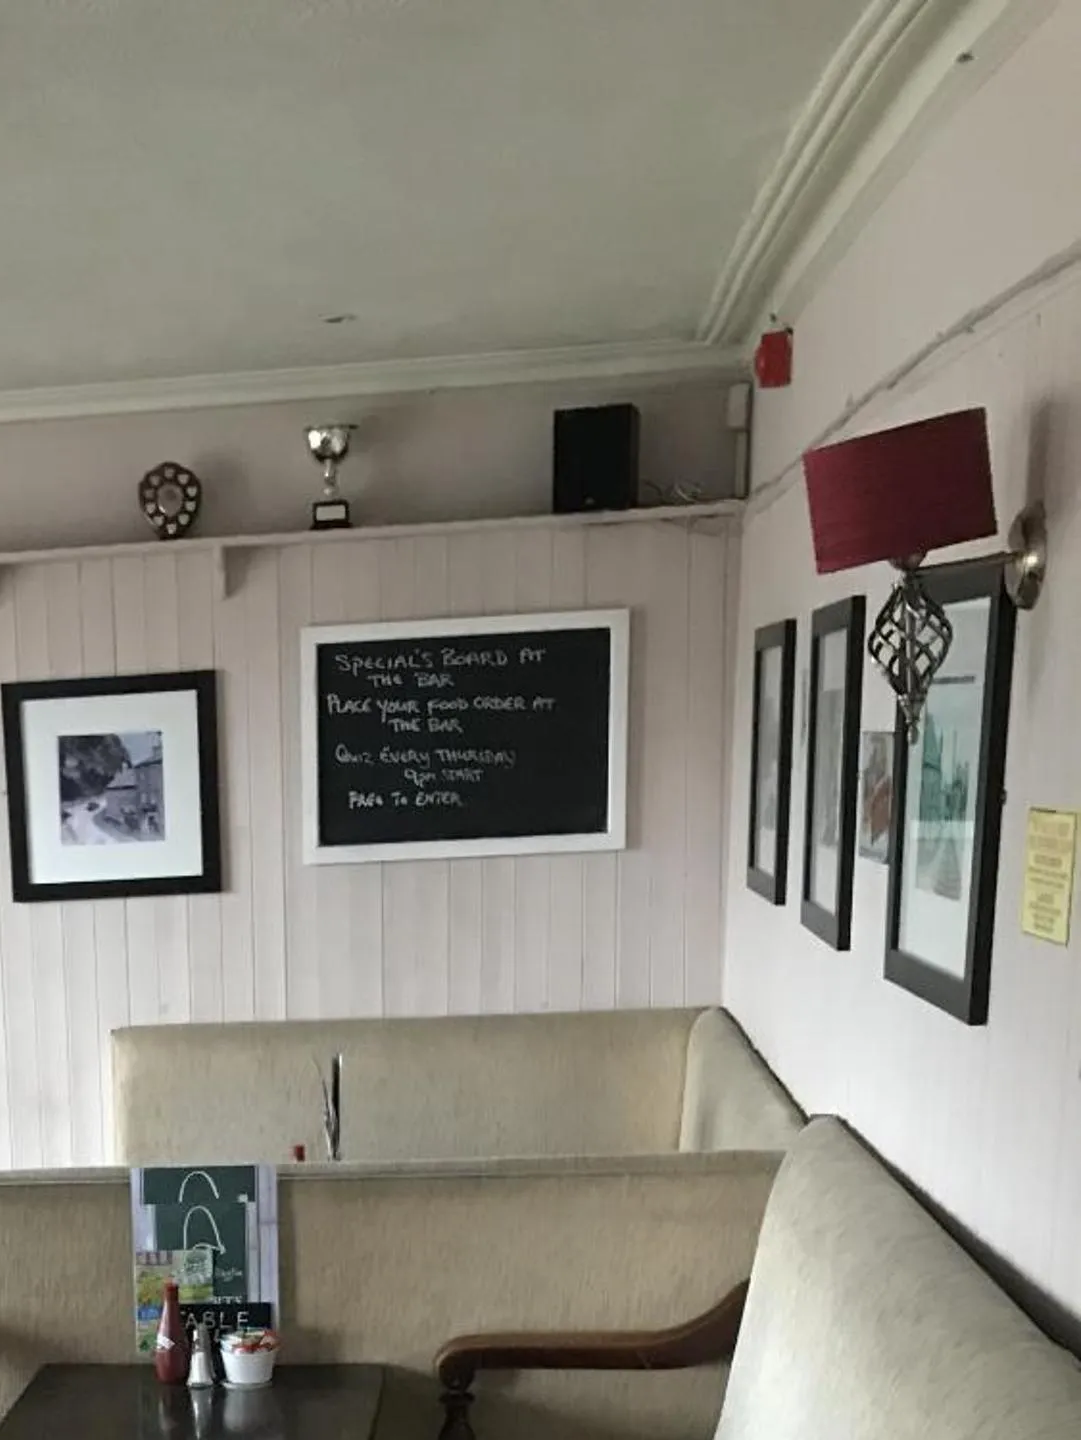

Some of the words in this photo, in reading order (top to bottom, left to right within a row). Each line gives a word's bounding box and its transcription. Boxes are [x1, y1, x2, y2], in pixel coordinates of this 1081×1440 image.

[441, 647, 508, 667] BOARD
[520, 646, 547, 664] AT
[414, 672, 455, 688] BAR
[327, 693, 372, 715] PLACE
[376, 698, 421, 723] YOUR
[427, 697, 468, 715] FOOD
[473, 695, 526, 711] ORDER
[532, 696, 556, 712] AT
[388, 717, 421, 733] THE
[427, 717, 464, 733] BAR
[379, 745, 430, 769] EVERY
[434, 749, 516, 769] THURSDAY
[442, 768, 485, 782] START
[415, 790, 463, 807] ENTER
[180, 1311, 249, 1329] ABLE
